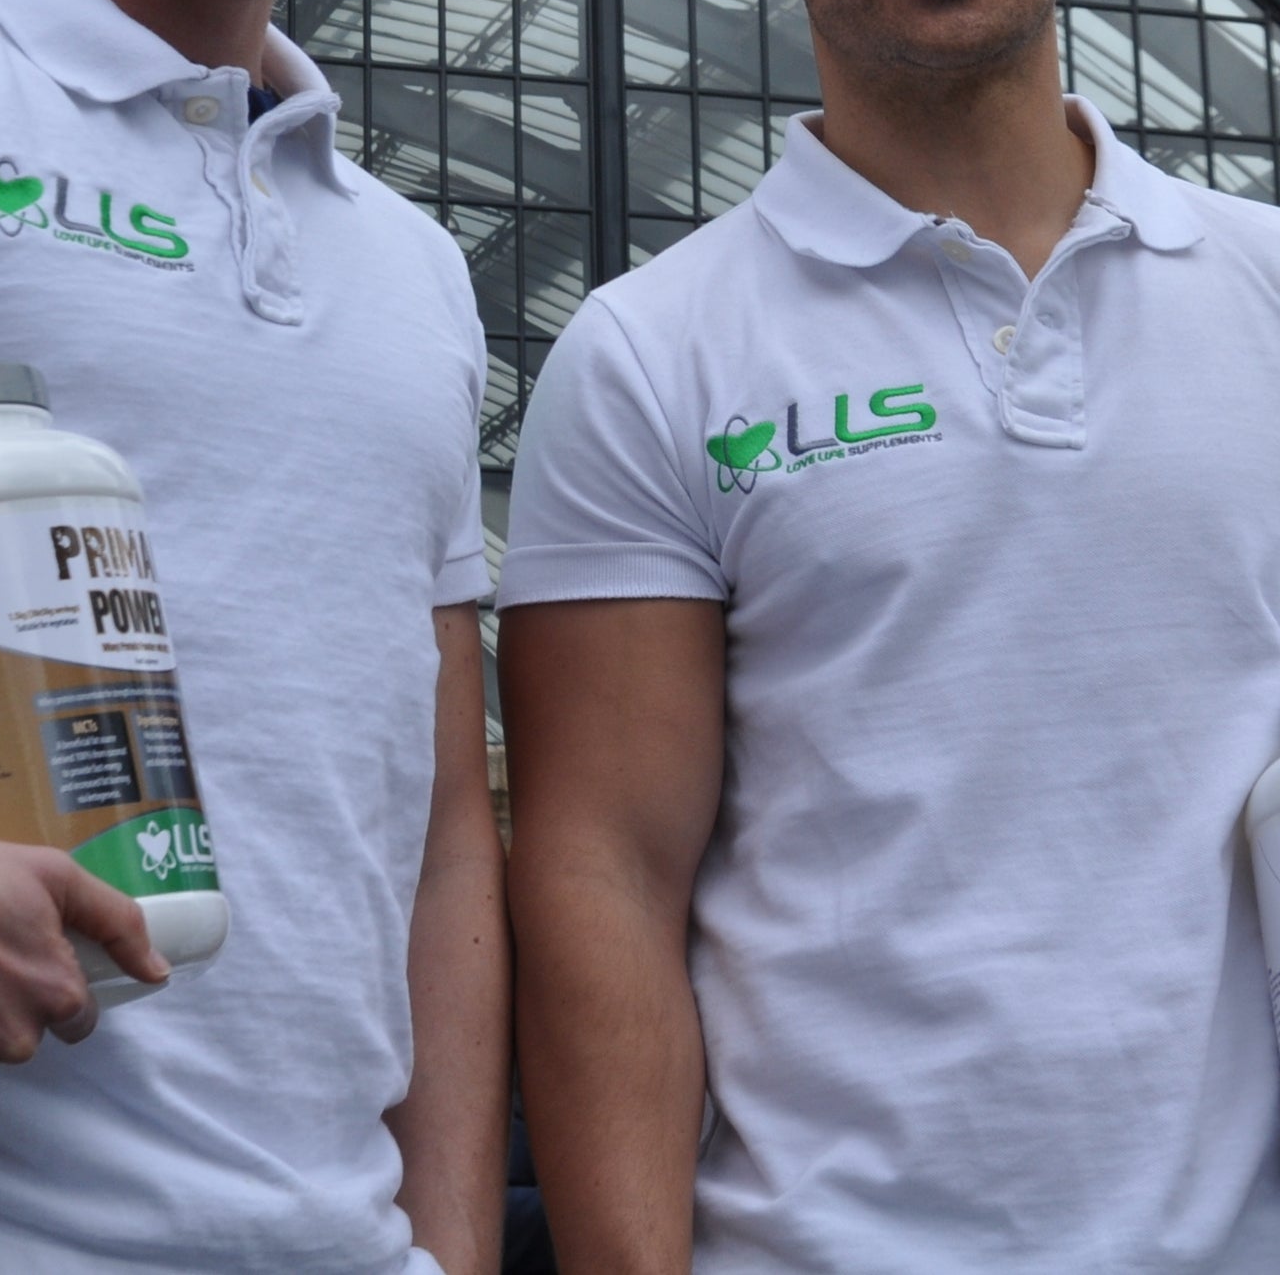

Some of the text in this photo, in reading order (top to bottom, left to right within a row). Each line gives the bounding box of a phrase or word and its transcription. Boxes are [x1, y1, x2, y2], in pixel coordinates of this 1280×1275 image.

[55, 177, 189, 258] LLS
[53, 229, 195, 272] LOVE LIFE SUPPLEMENTS
[787, 384, 937, 456] LLS
[786, 433, 943, 474] LOVE LIFE SUPPLEMENTS
[50, 526, 155, 582] PRIMA
